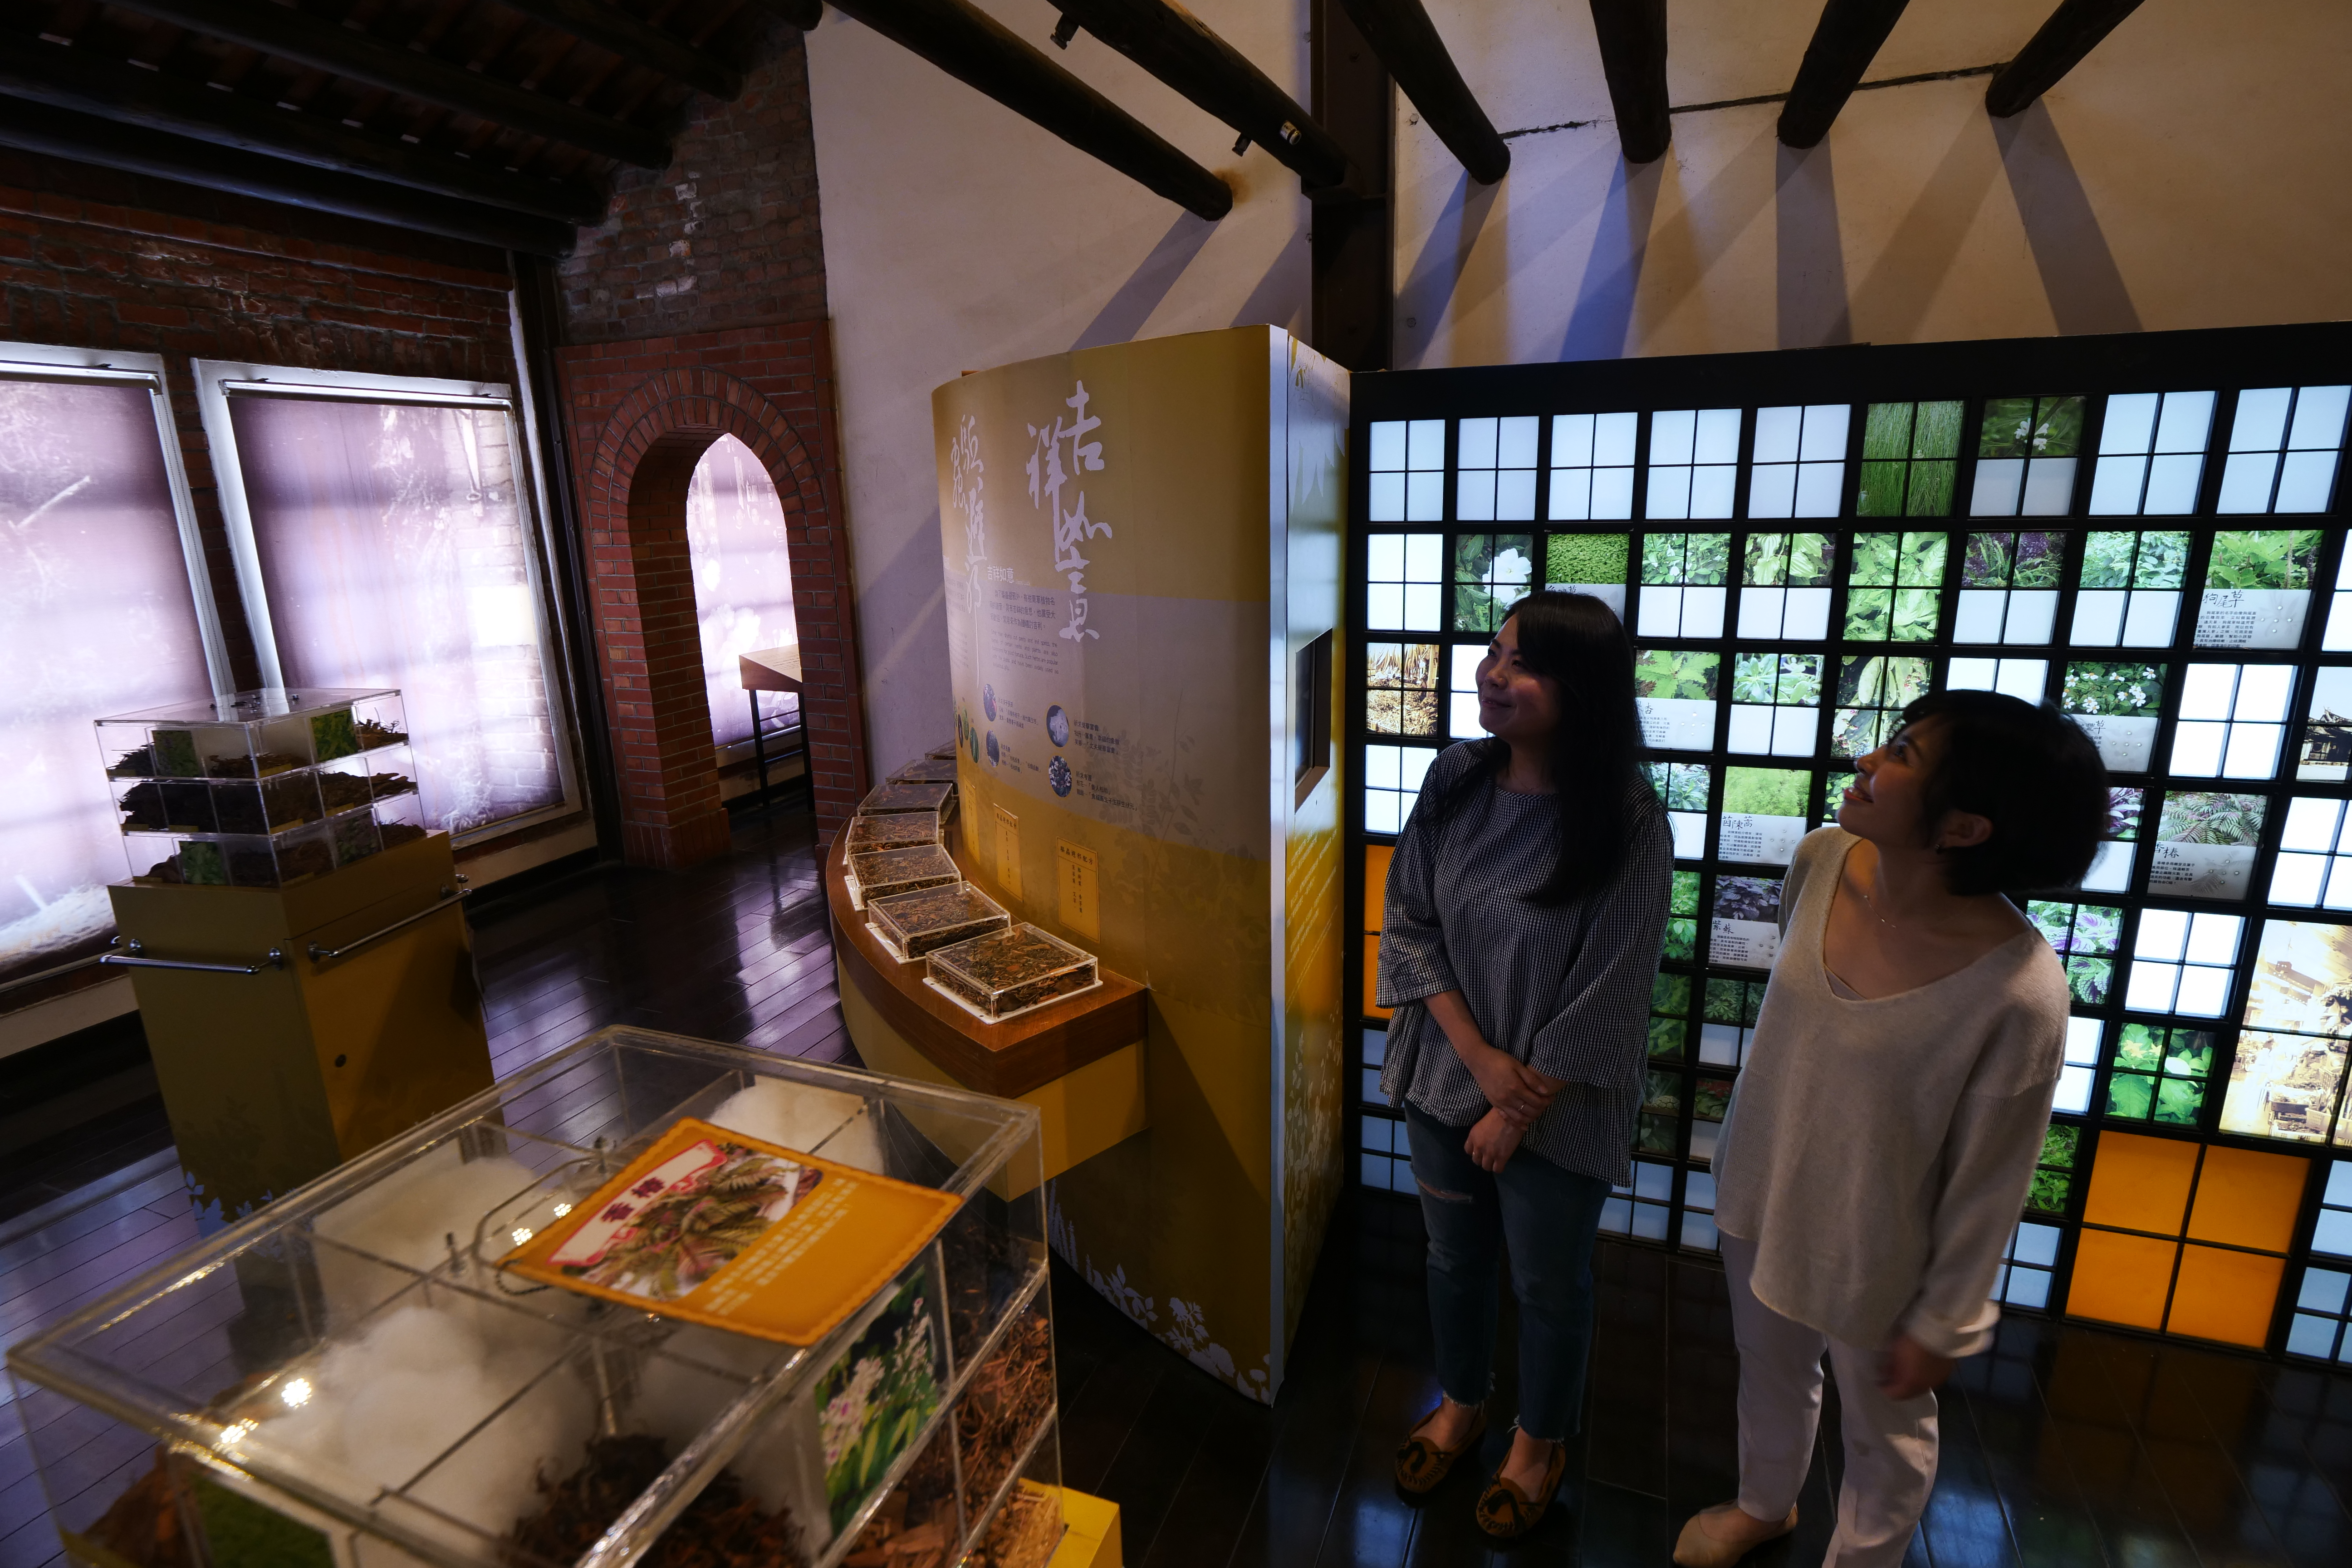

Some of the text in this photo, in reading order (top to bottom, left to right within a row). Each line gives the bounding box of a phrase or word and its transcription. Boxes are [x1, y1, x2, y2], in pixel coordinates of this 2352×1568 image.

[987, 565, 1014, 583] 吉祥如意
[2203, 590, 2244, 608] 狗尾草
[1722, 815, 1752, 830] 茵陳蒿
[1713, 920, 1734, 934] 紫蘇
